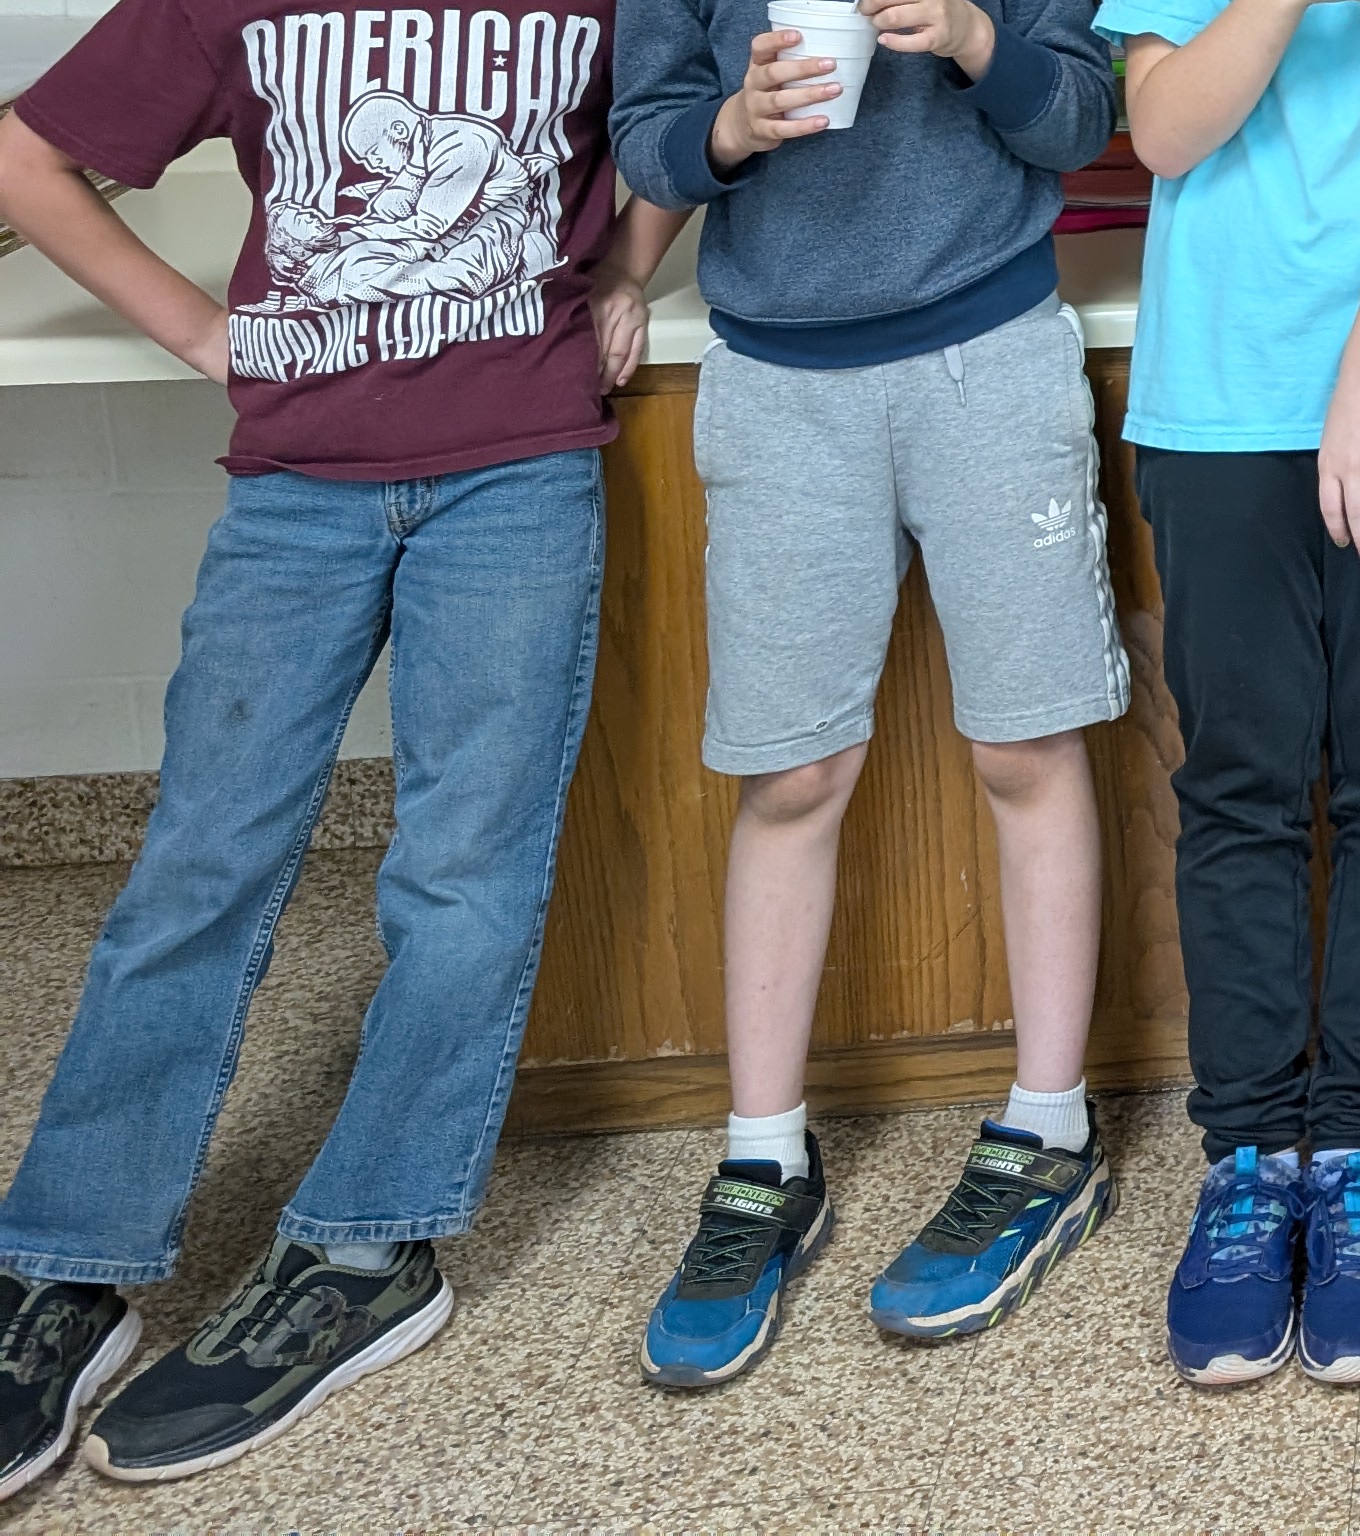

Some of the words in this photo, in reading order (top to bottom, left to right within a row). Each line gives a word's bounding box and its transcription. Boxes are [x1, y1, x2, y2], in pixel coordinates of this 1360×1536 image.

[241, 9, 601, 221] AMERICAN
[227, 304, 371, 384] GRAPPLING
[377, 279, 546, 365] FEDERATION
[1033, 527, 1076, 548] adidas
[970, 1155, 1024, 1173] S-LIGHTS
[714, 1194, 775, 1215] S-LIGHTS
